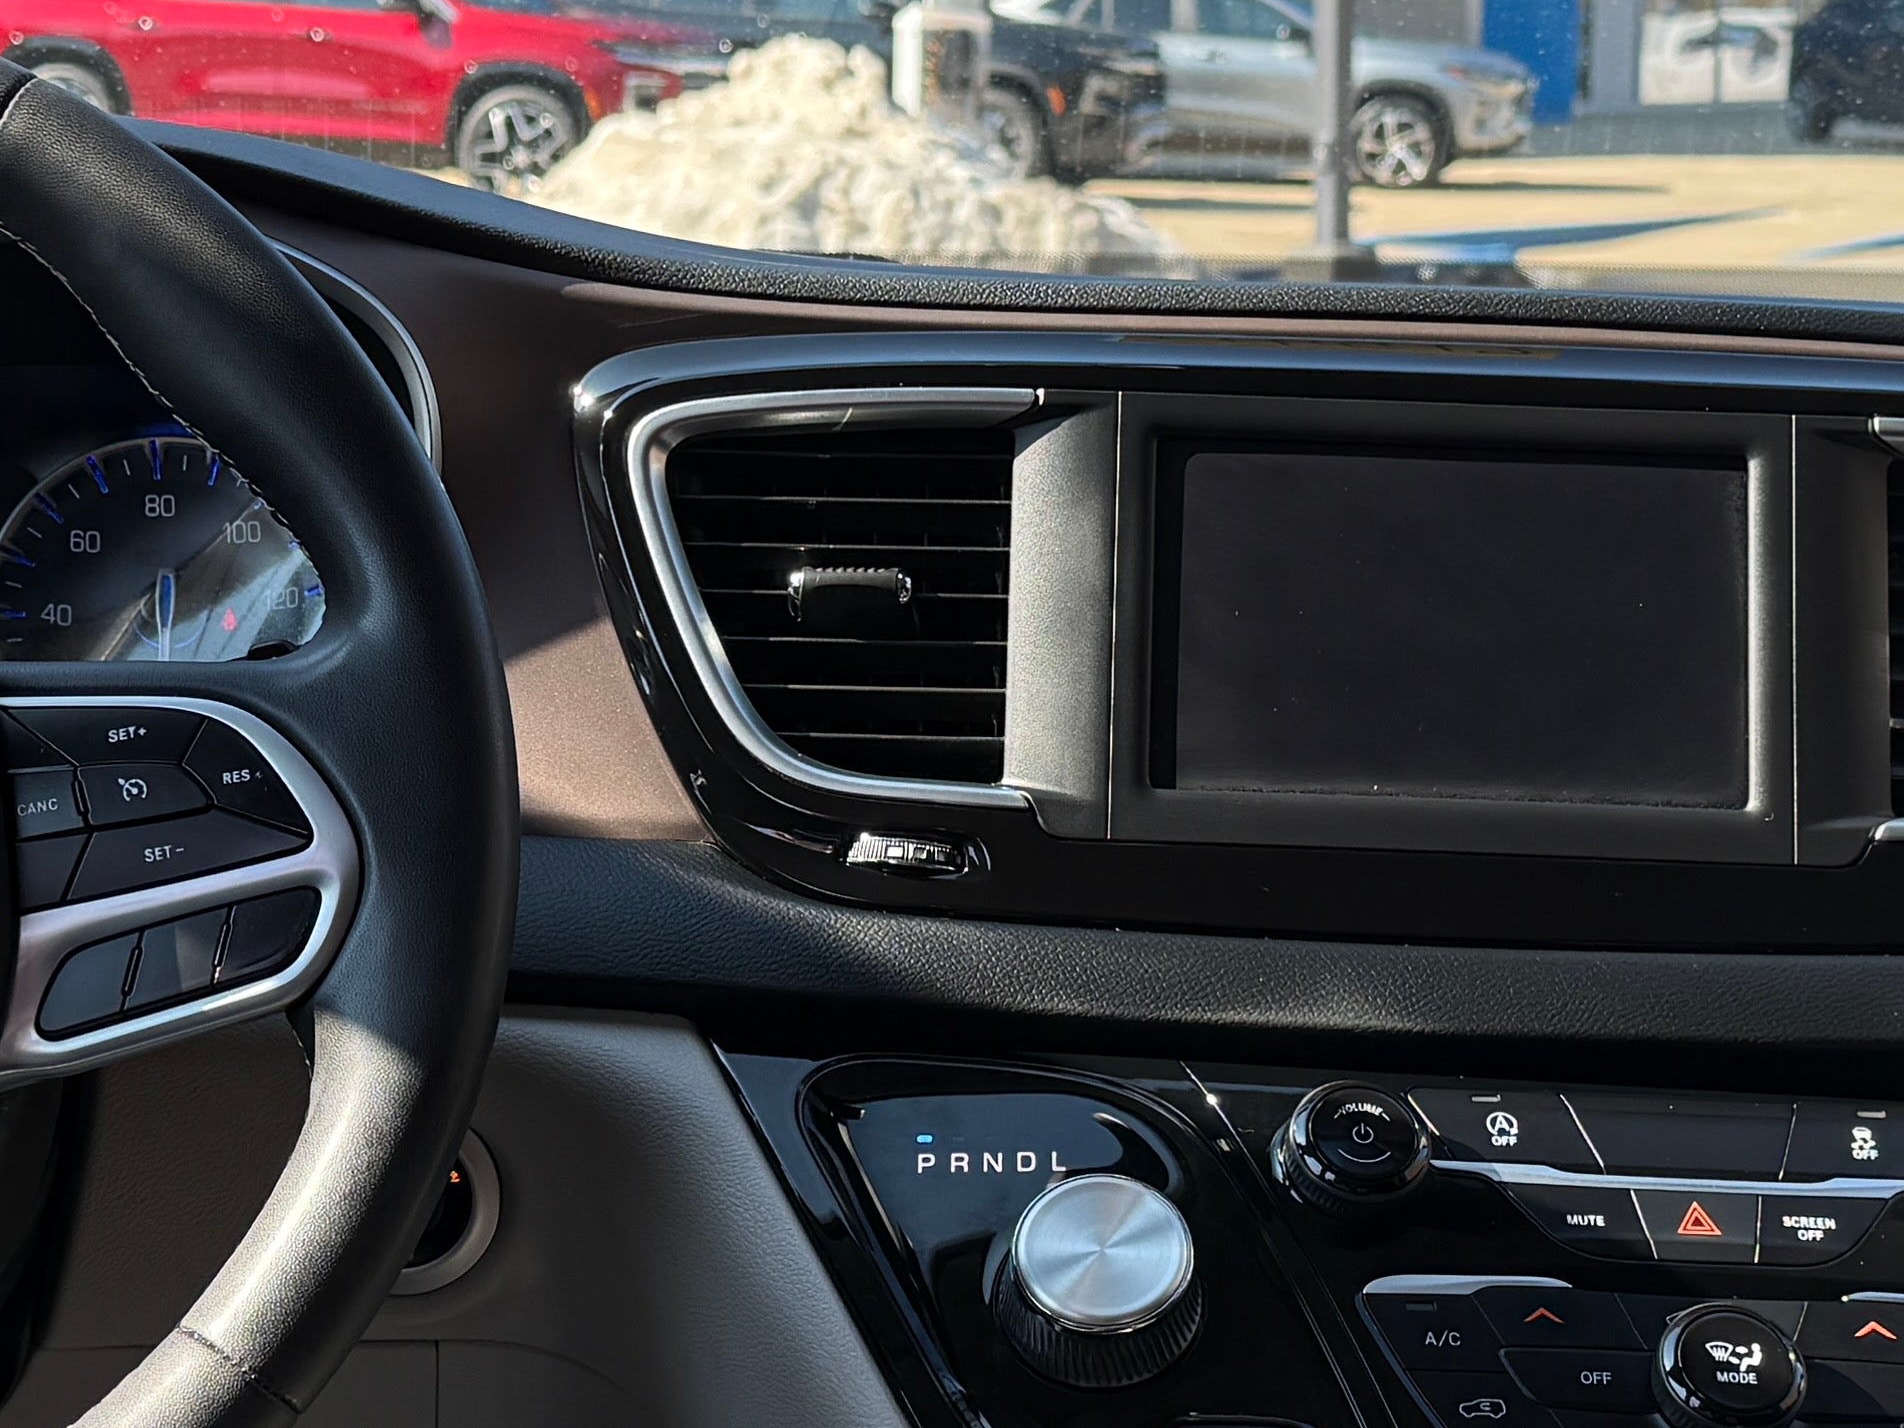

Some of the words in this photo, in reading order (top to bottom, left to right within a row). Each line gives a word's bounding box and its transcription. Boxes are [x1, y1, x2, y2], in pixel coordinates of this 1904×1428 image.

[144, 494, 176, 519] 80
[223, 519, 261, 545] 100
[69, 529, 101, 554] 60
[264, 587, 299, 611] 120
[40, 602, 73, 626] 40
[222, 769, 251, 786] RES
[17, 798, 59, 818] CANC
[1339, 1101, 1384, 1117] VOLUME
[1490, 1134, 1517, 1147] OFF
[1851, 1148, 1879, 1161] OFF
[1566, 1214, 1606, 1227] MUTE
[1782, 1215, 1836, 1230] SCREEN
[1797, 1229, 1824, 1241] OFF
[1424, 1331, 1461, 1348] A/C
[1580, 1370, 1612, 1386] OFF
[1716, 1369, 1758, 1386] MODE
